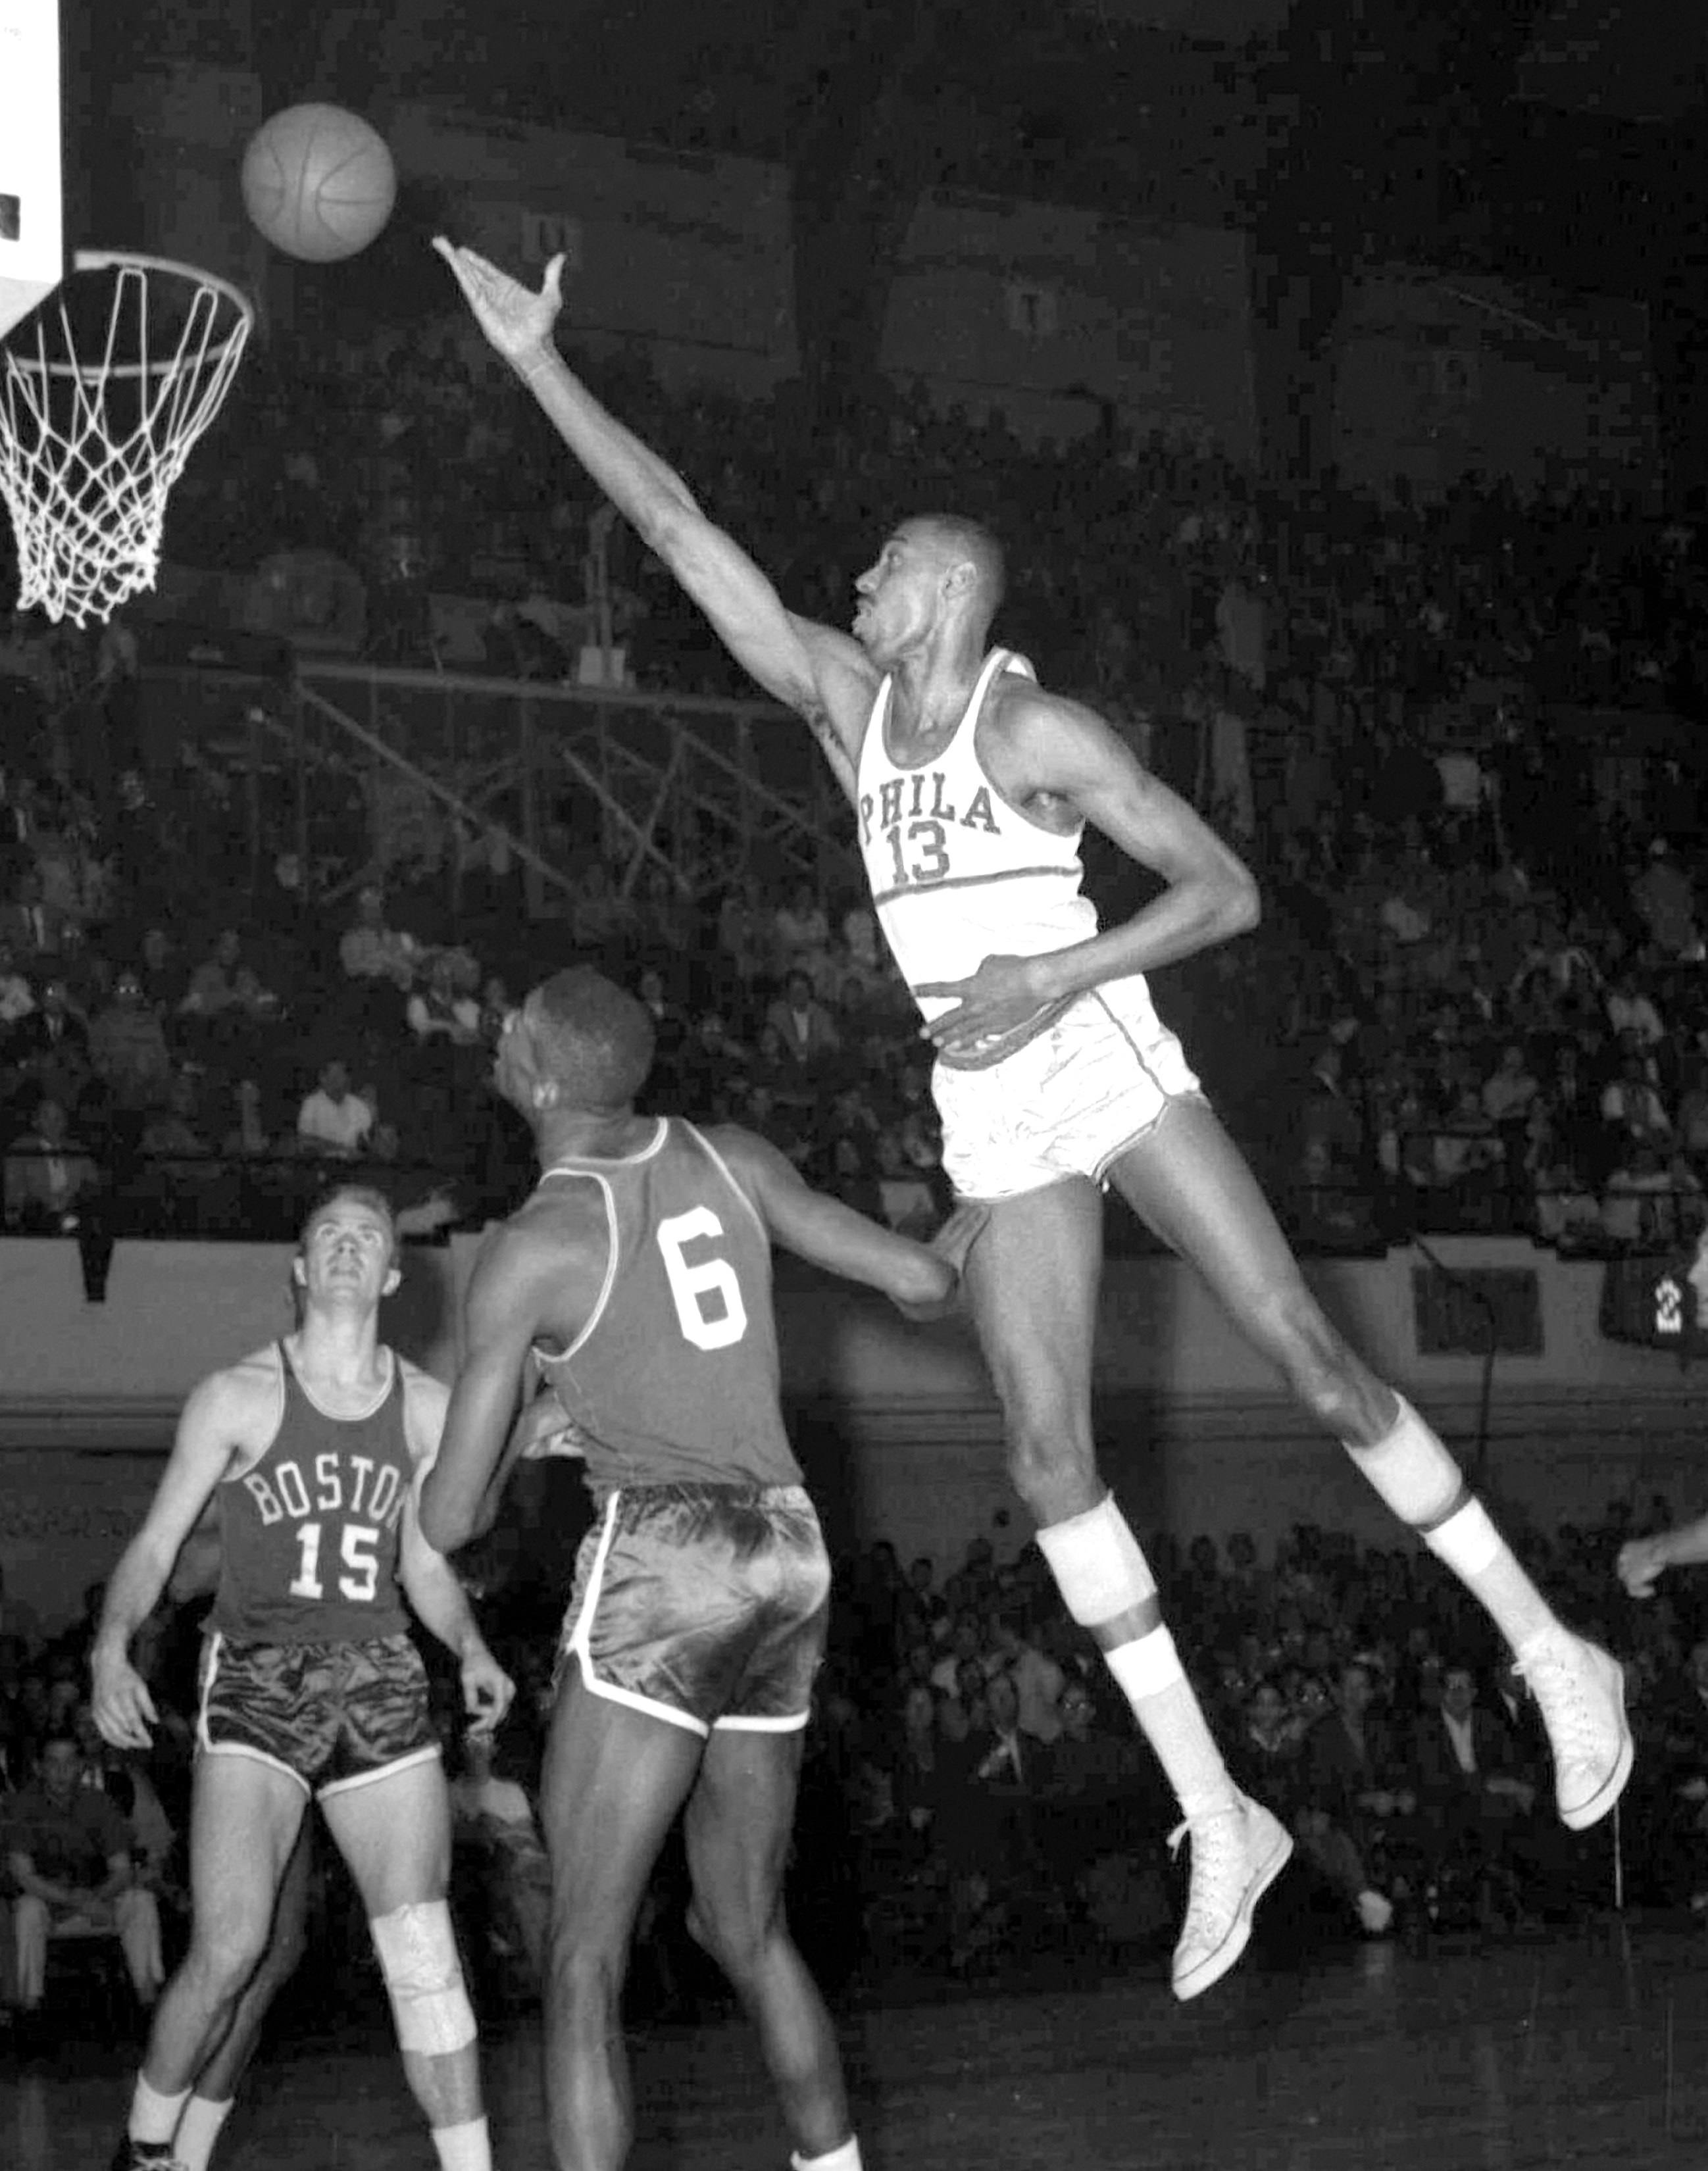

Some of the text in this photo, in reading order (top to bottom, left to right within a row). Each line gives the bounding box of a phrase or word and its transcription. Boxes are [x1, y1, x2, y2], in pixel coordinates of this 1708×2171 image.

[861, 772, 1001, 846] PHILA
[886, 820, 950, 884] 13
[657, 1206, 747, 1351] 6
[289, 1523, 380, 1601] 15
